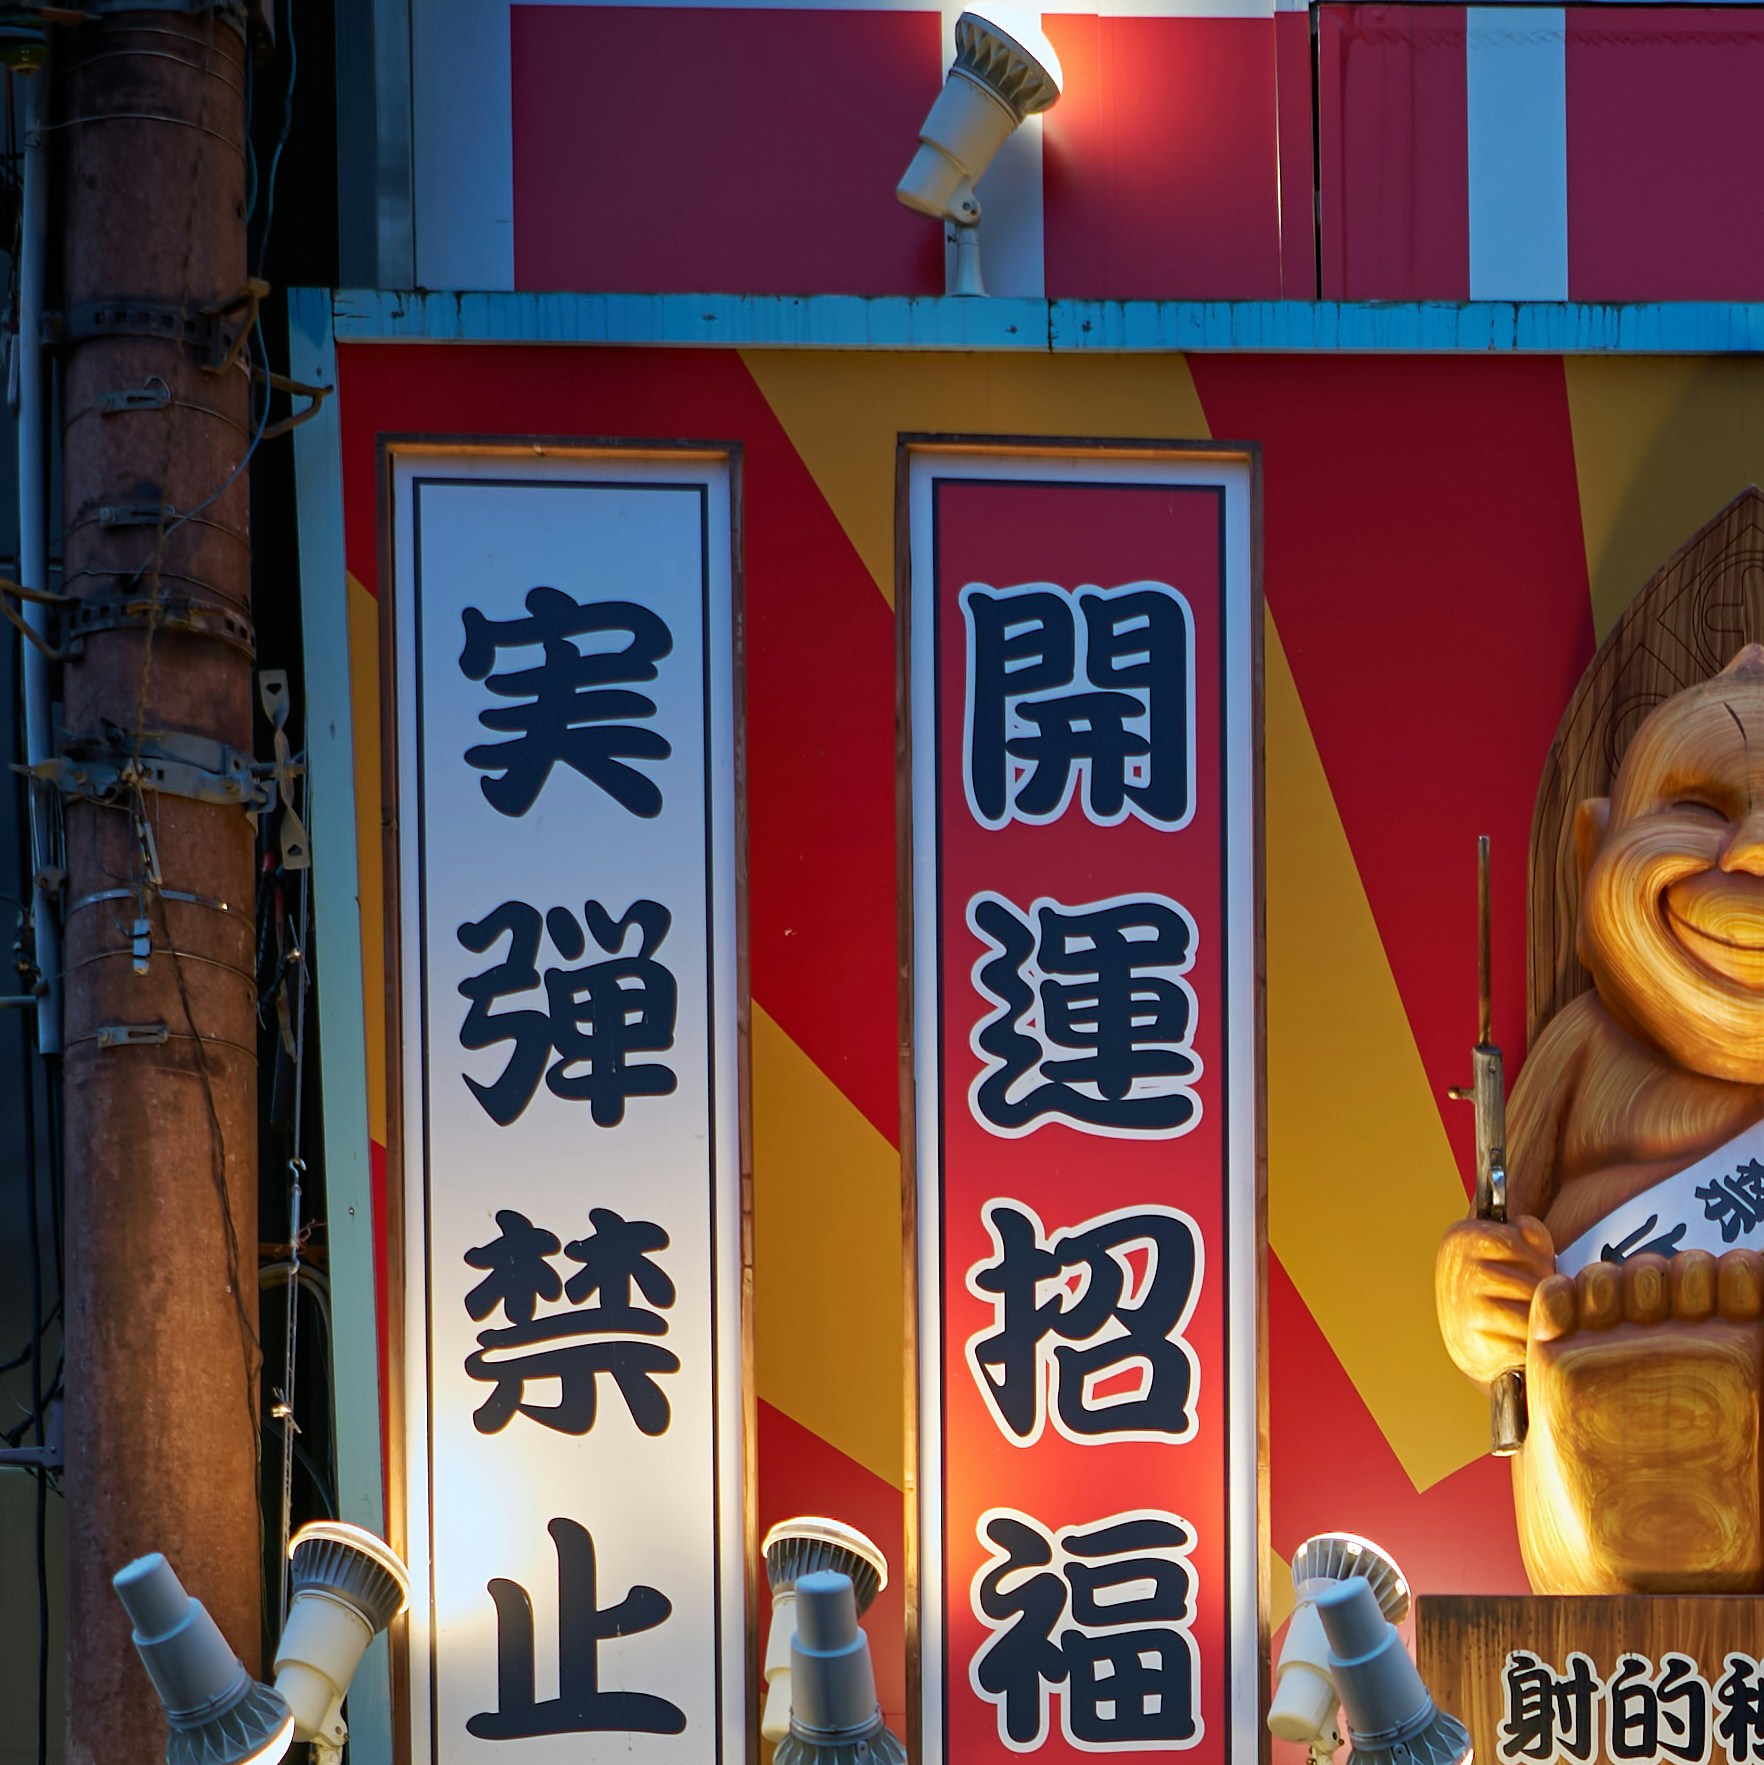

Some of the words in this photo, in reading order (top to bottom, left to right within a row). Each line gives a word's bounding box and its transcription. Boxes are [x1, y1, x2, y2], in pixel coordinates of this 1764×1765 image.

[458, 587, 687, 1740] 実弾禁止
[960, 580, 1206, 1756] 開運招福
